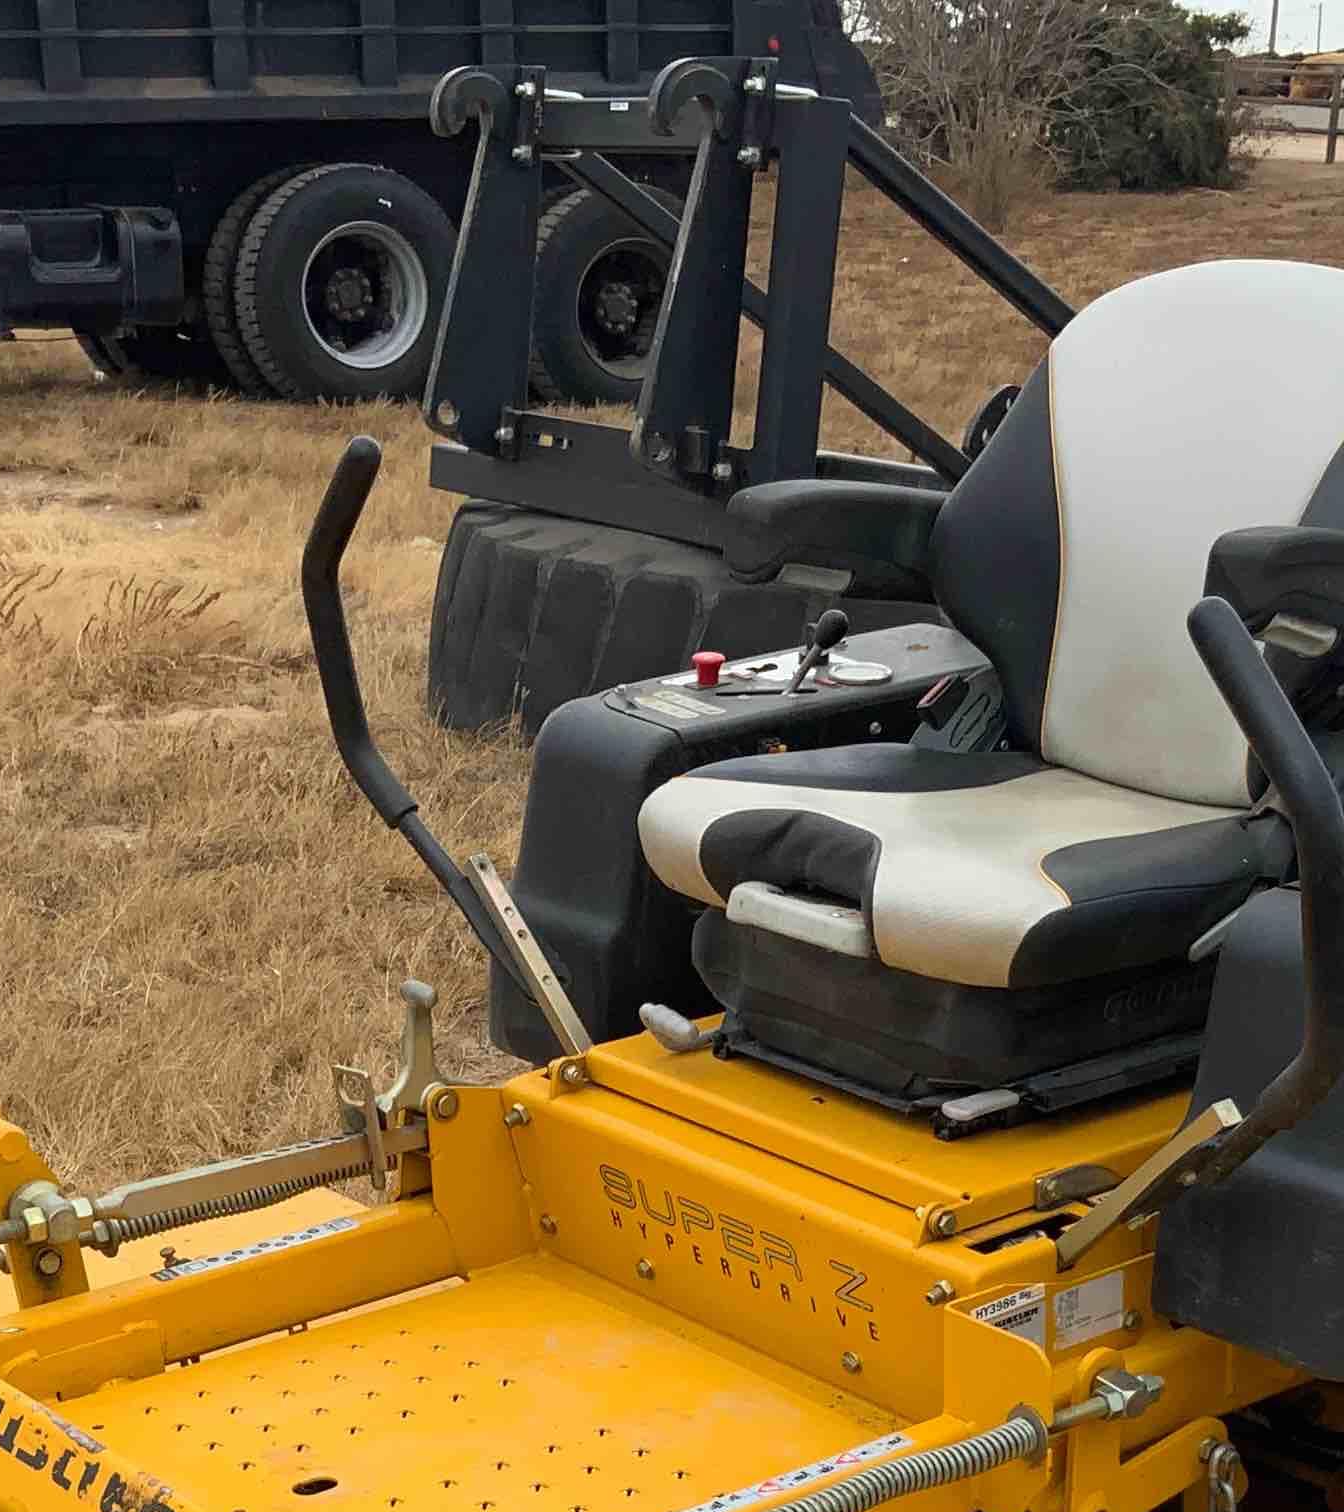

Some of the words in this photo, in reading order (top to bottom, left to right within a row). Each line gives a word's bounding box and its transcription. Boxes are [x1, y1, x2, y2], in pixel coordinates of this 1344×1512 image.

[600, 1163, 803, 1282] SUPER
[828, 1259, 873, 1312] Z
[611, 1208, 880, 1341] HYPERDRIVE
